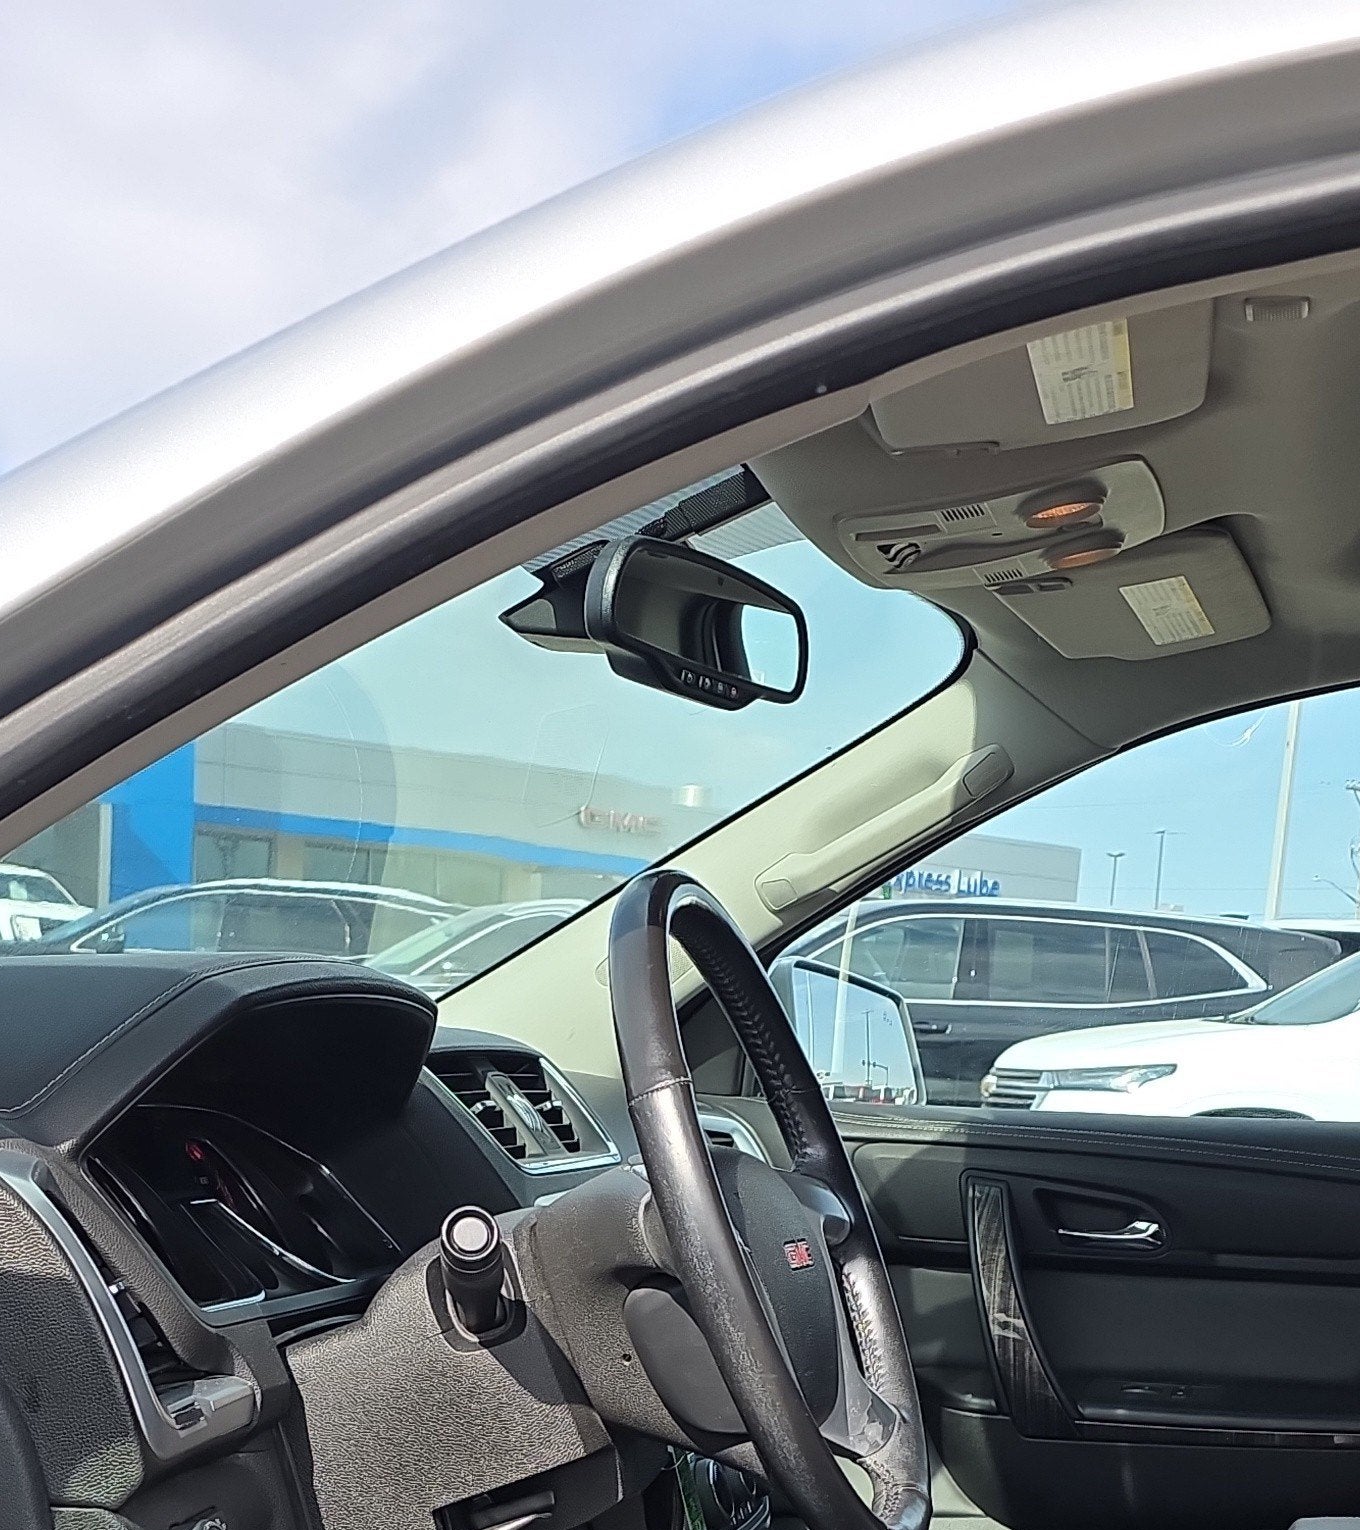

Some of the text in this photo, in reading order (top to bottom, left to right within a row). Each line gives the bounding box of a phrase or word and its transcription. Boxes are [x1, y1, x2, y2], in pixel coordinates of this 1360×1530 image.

[579, 807, 661, 834] GMC
[891, 868, 1001, 897] xpress Lube
